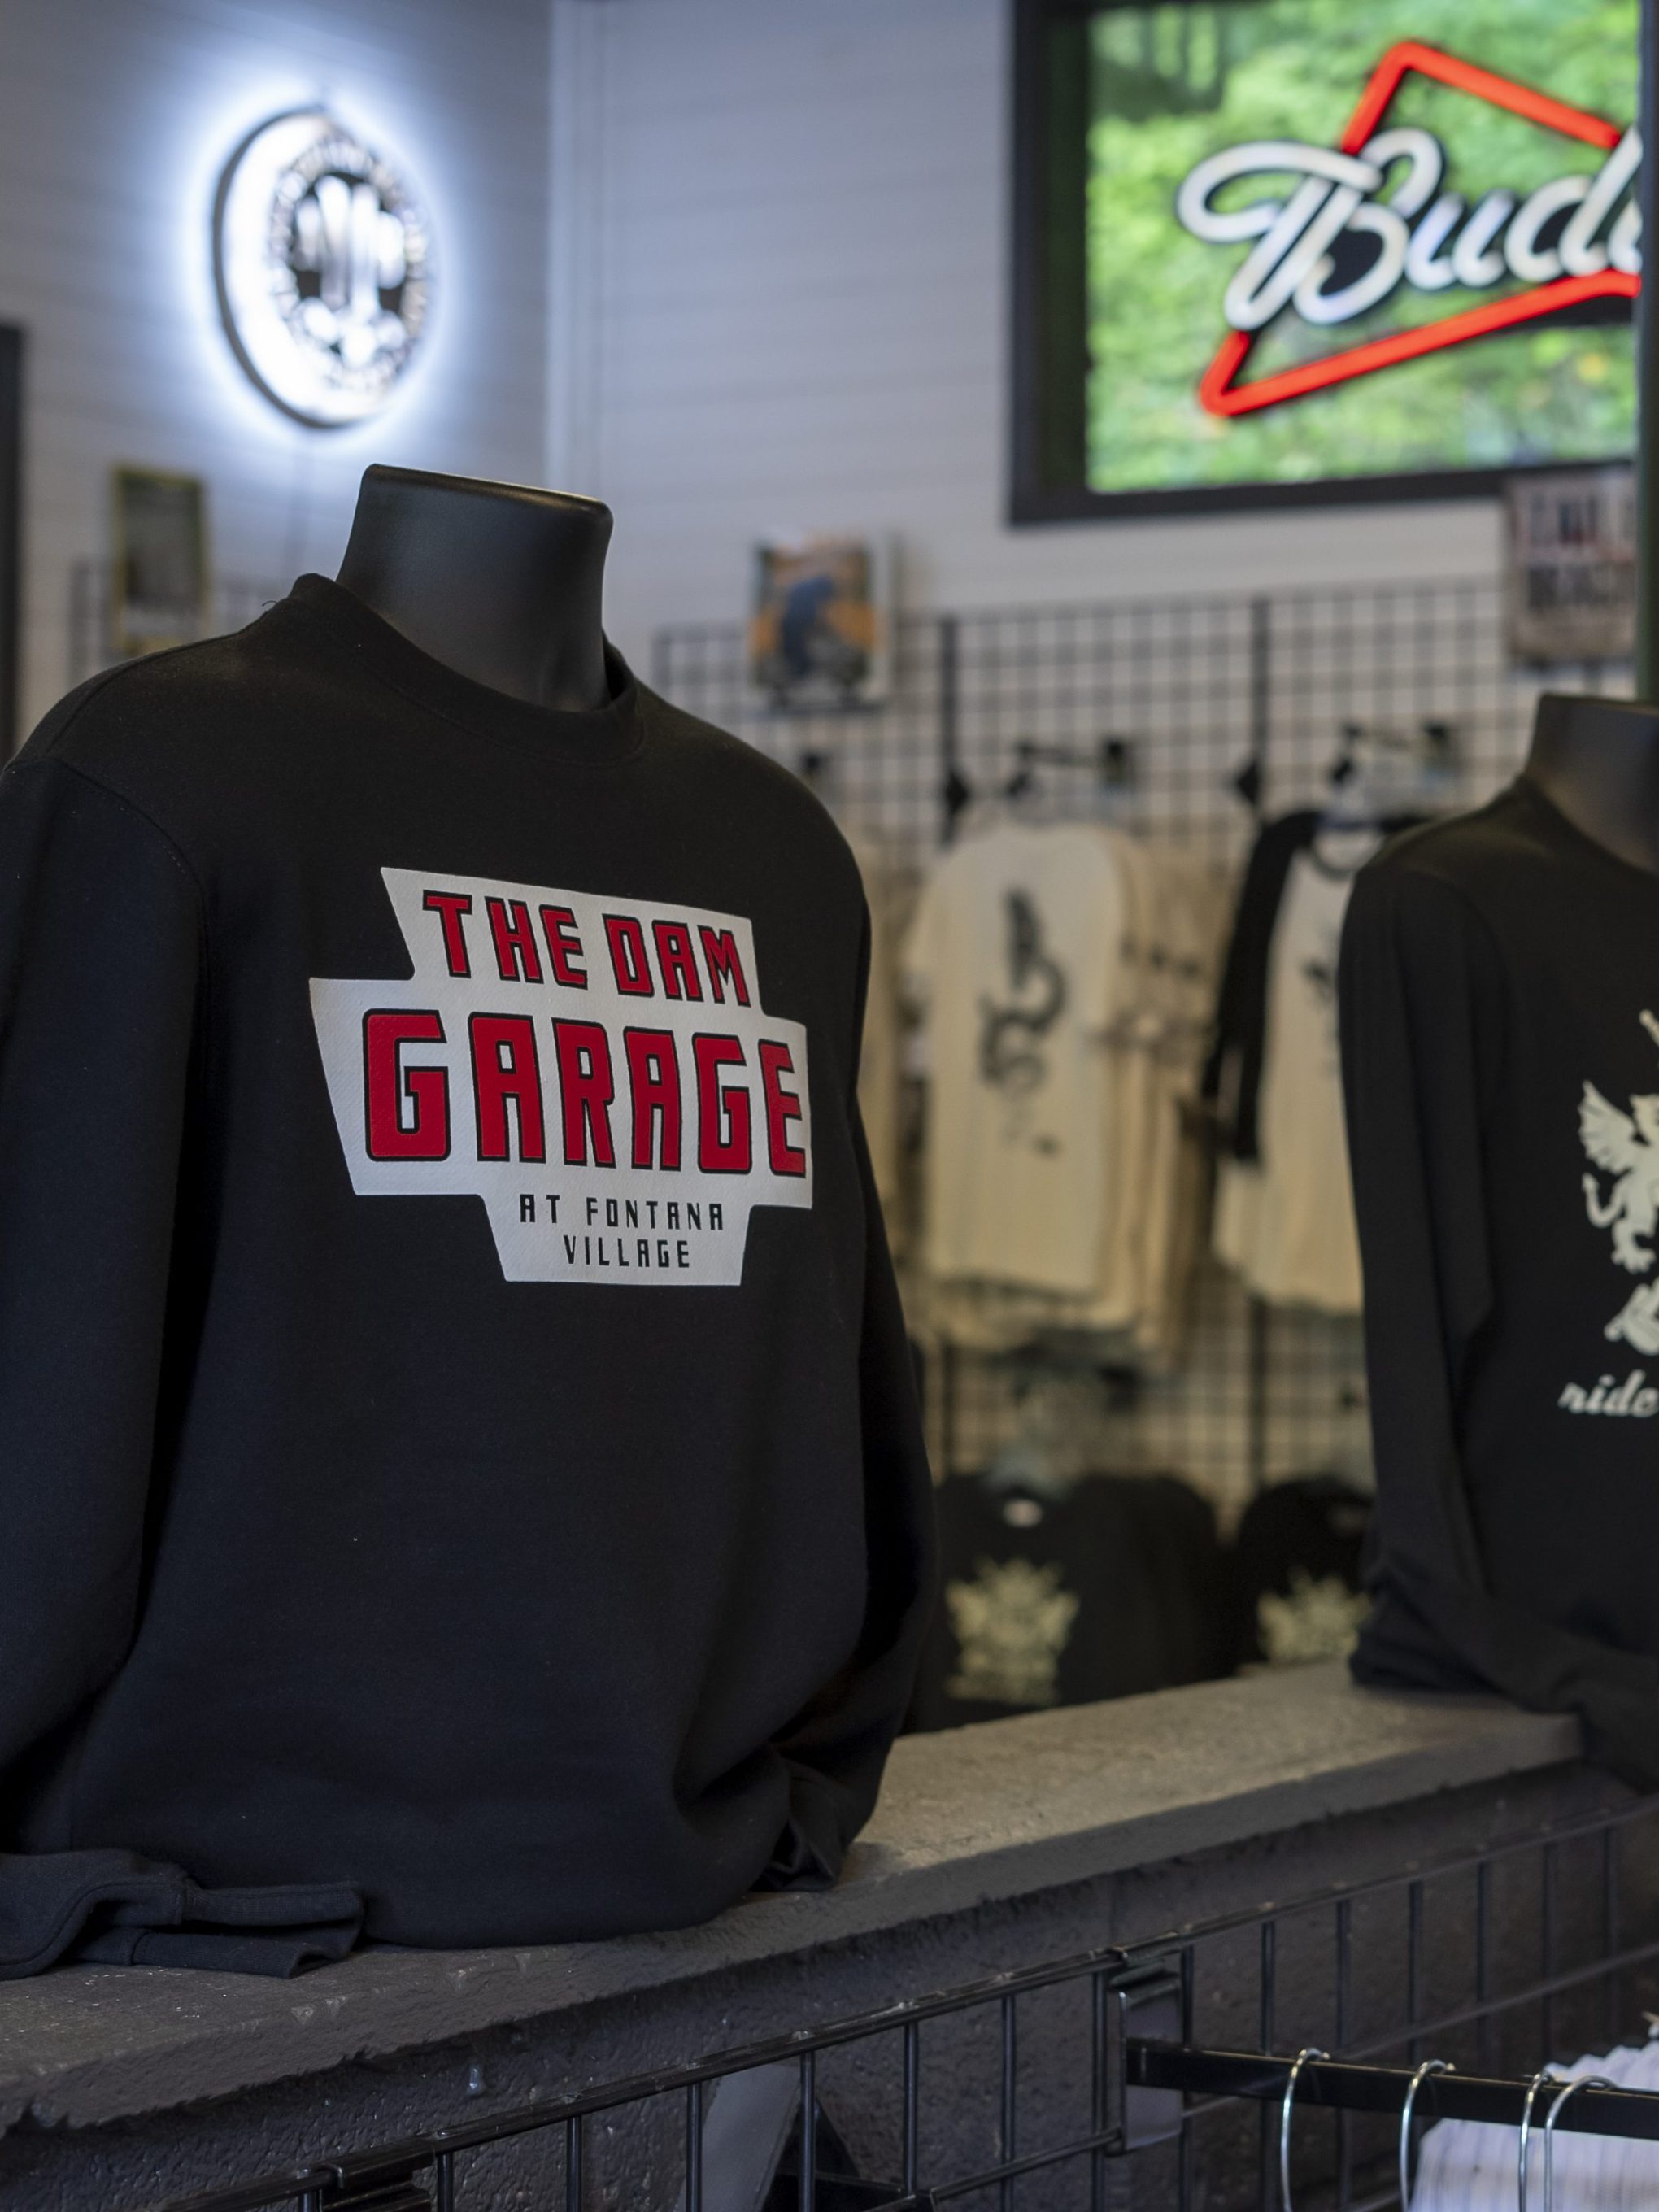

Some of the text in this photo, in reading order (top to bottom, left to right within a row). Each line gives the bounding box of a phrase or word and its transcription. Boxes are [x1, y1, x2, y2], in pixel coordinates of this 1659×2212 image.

[422, 890, 751, 1008] THE DAM
[362, 1008, 807, 1179] GARAGE
[520, 1193, 723, 1231] AT FONTANA
[564, 1234, 690, 1268] VILLAGE
[1557, 1369, 1659, 1417] ride
